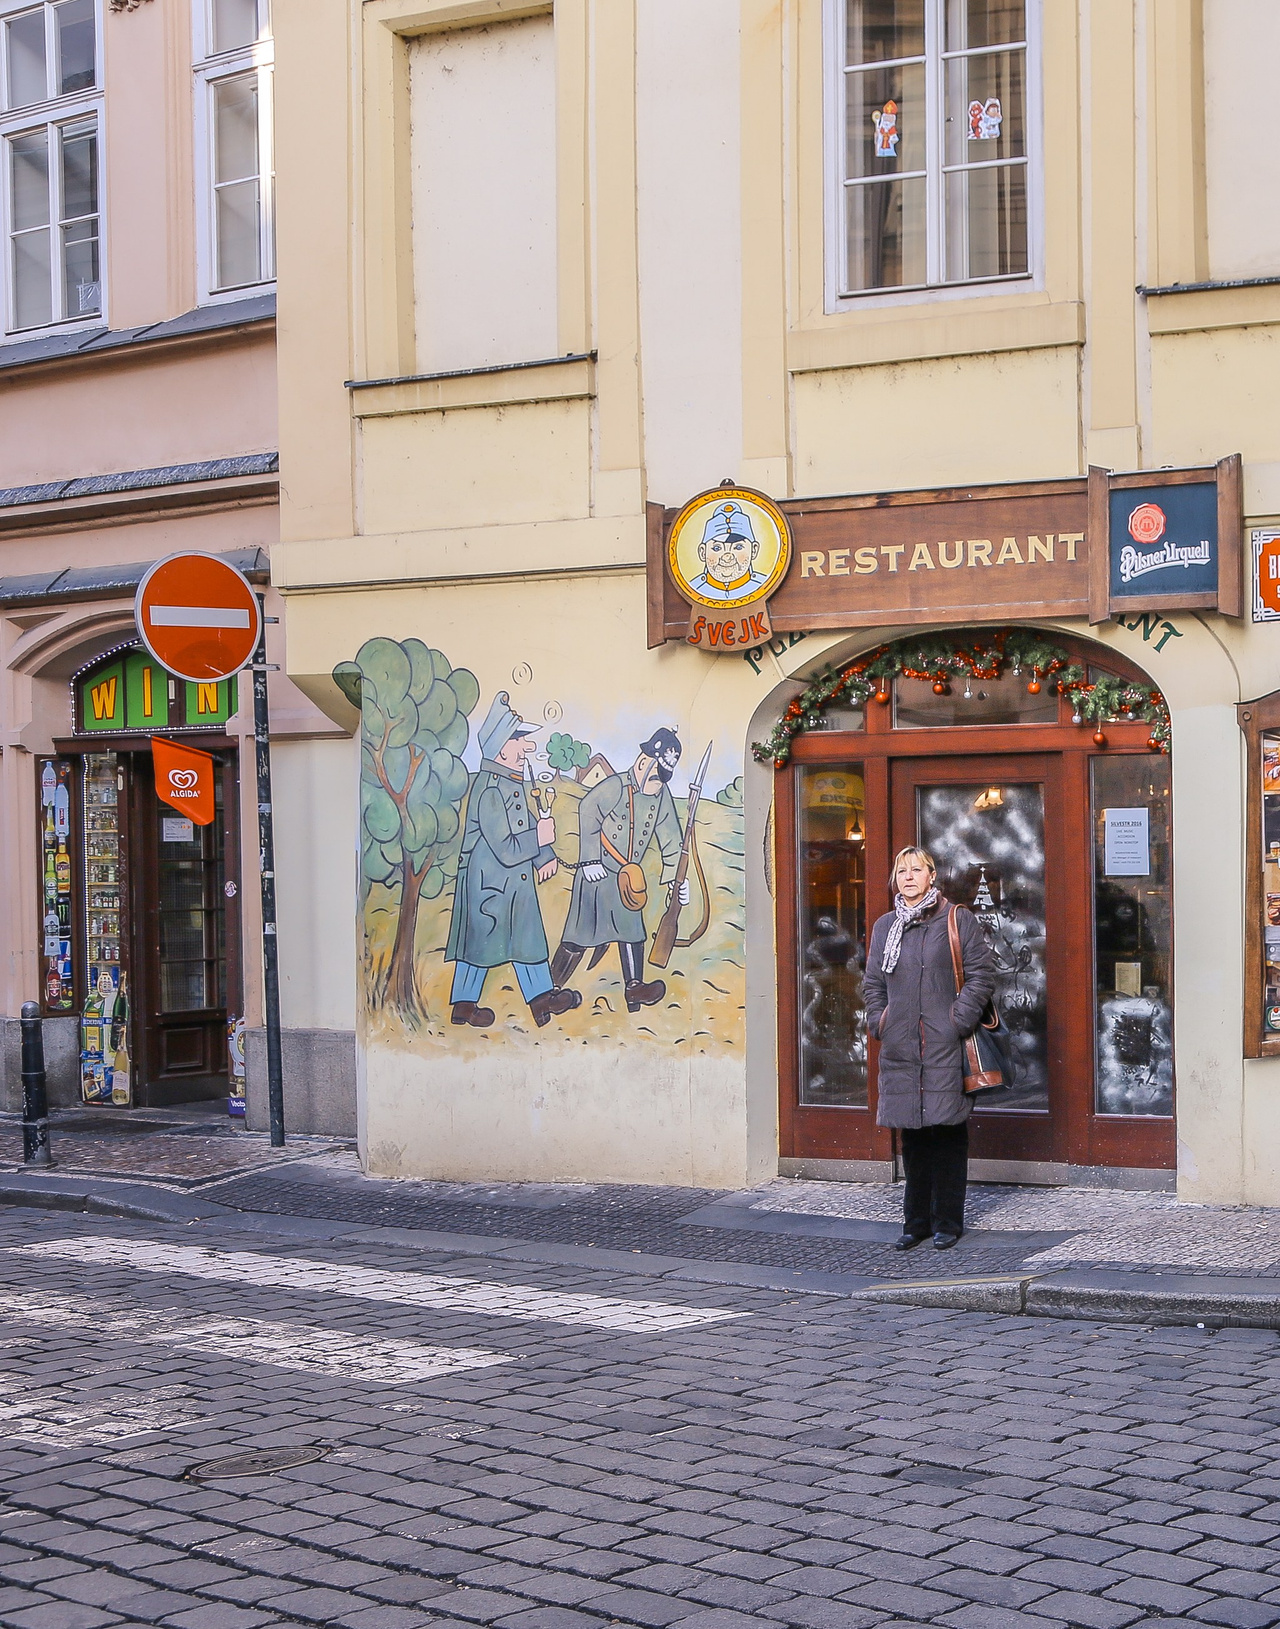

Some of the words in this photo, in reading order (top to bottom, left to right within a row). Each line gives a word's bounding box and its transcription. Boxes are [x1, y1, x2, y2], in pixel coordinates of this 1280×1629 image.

[800, 531, 1085, 580] RESTAURANT
[1120, 545, 1166, 583] Pilsner
[1164, 540, 1211, 569] Urquell
[692, 611, 771, 647] ŠVEJK
[170, 789, 199, 798] ALGIDA
